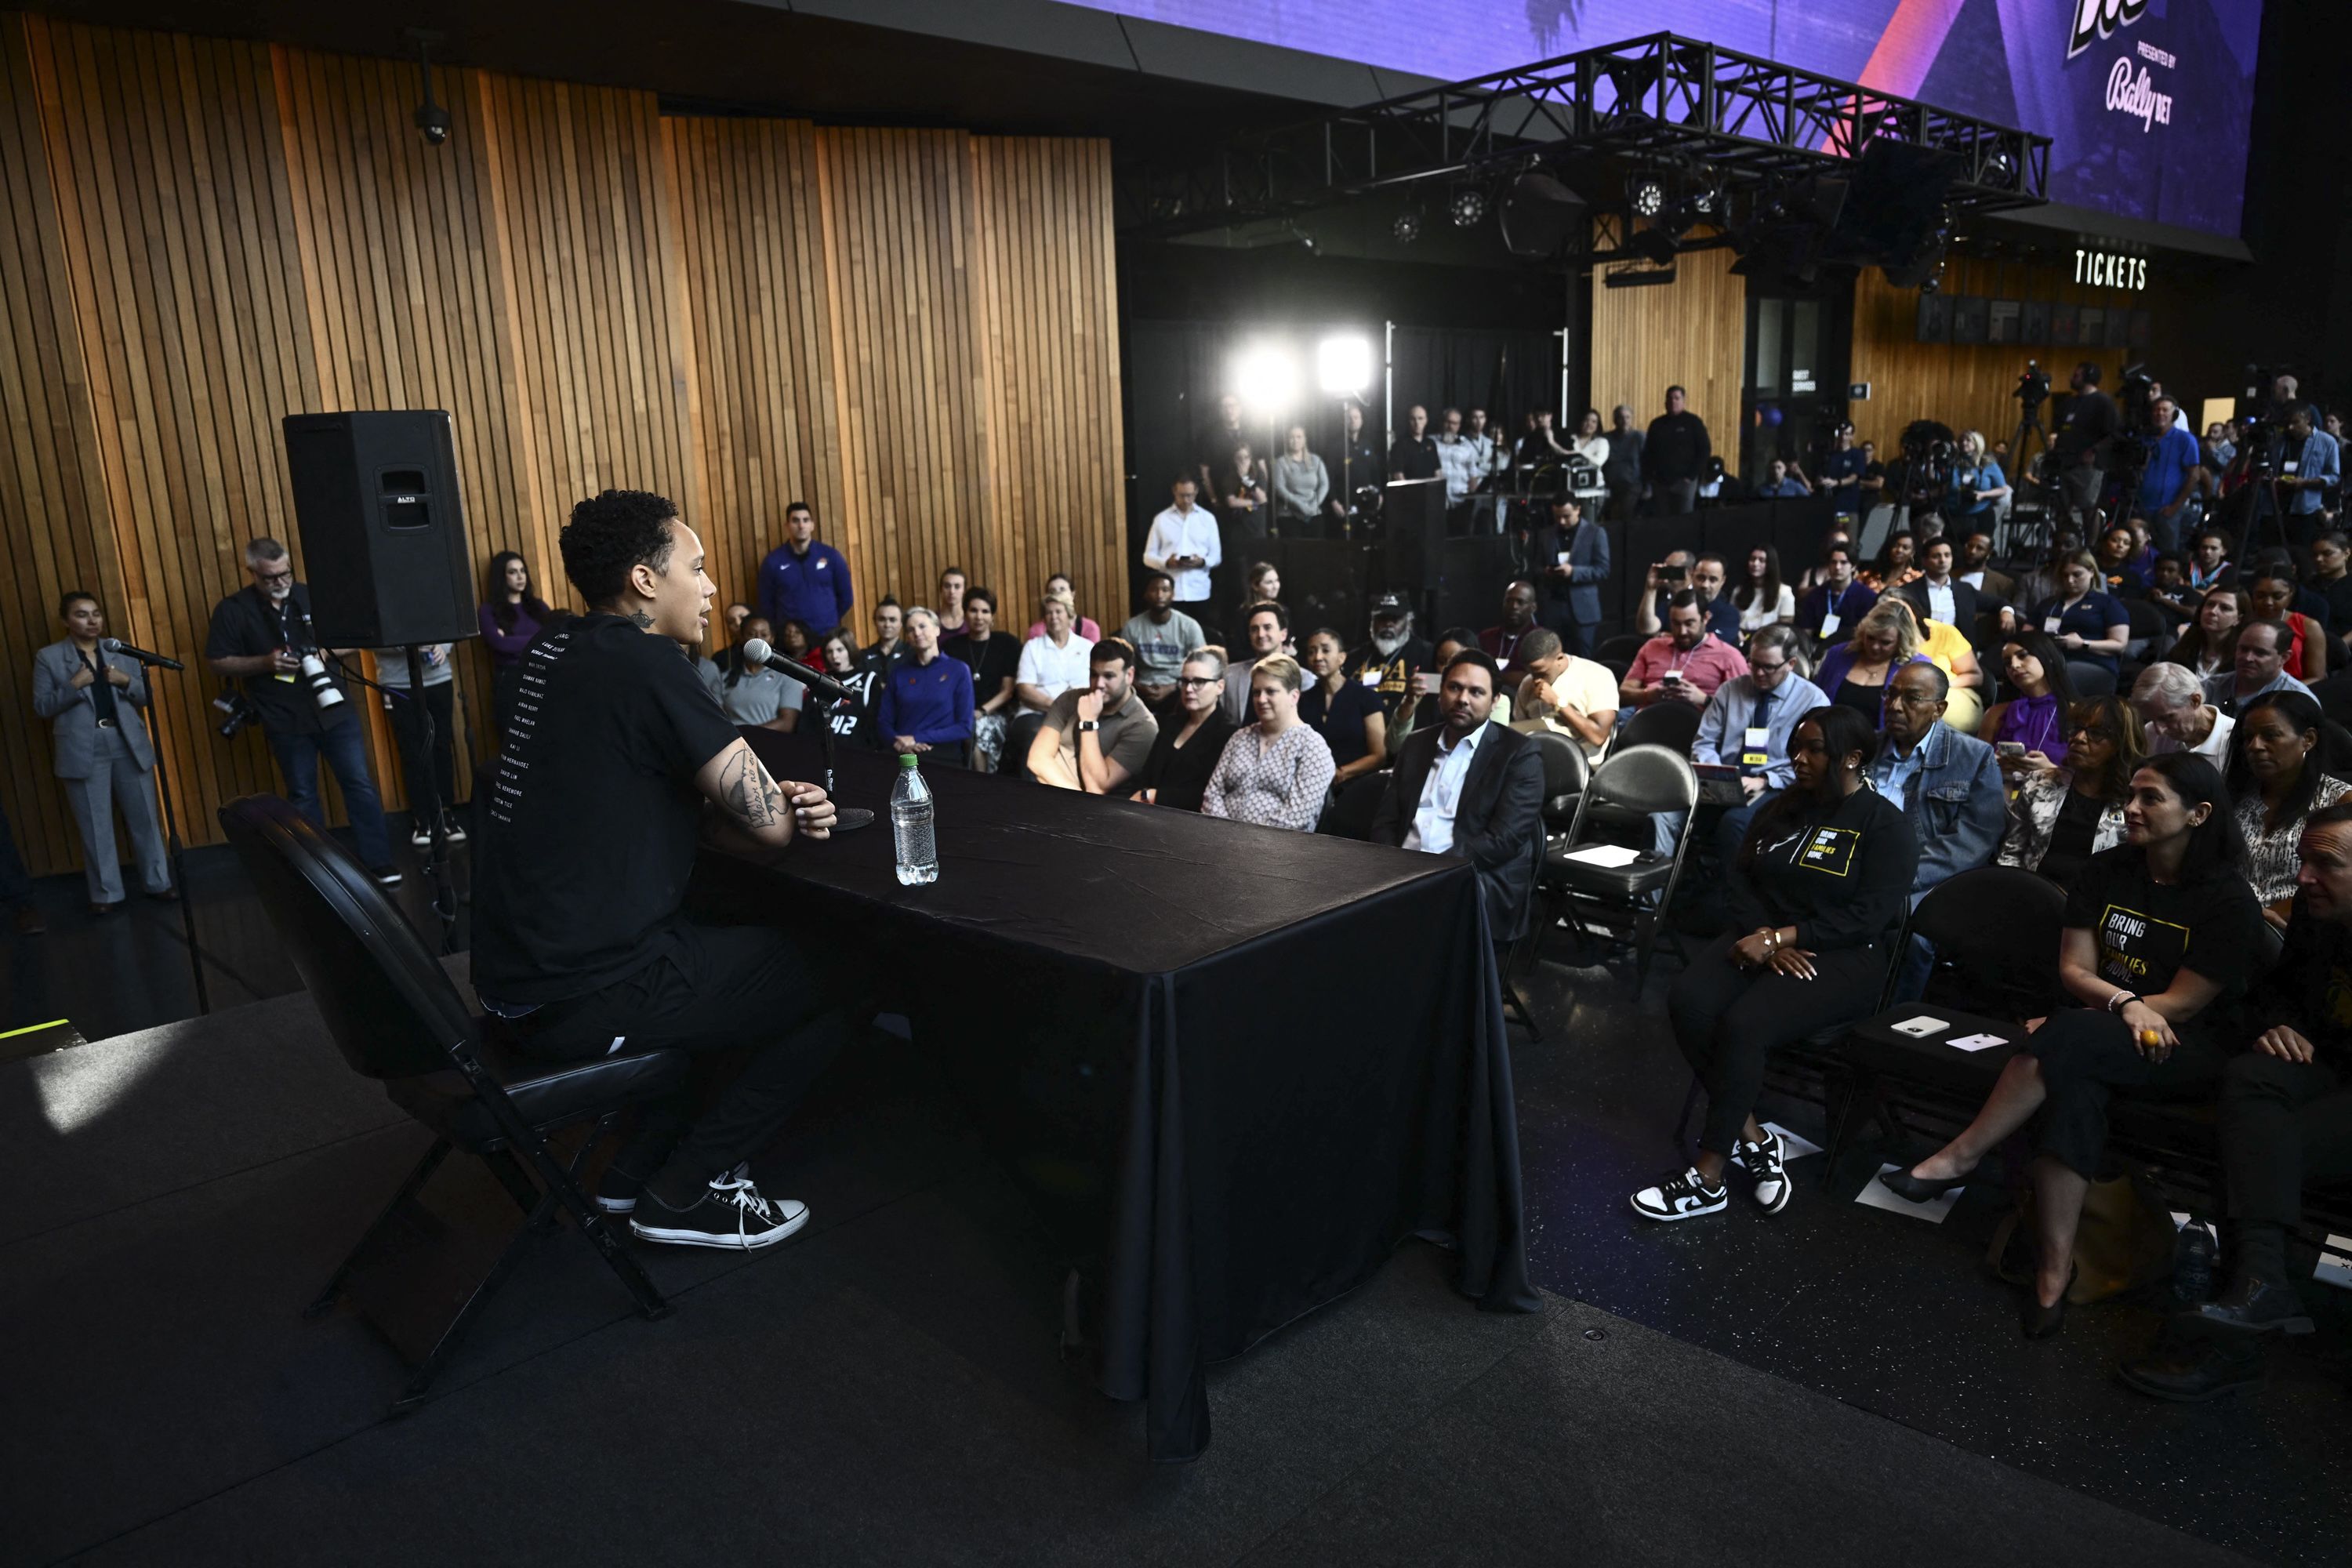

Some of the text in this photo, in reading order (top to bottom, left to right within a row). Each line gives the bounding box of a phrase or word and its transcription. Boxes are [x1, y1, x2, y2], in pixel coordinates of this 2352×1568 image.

[2137, 40, 2176, 70] PRESENTED BY
[2106, 56, 2172, 133] Bally BET
[2075, 249, 2147, 291] TICKETS
[831, 715, 858, 735] 42
[507, 757, 529, 768] HERNANDEZ
[750, 770, 757, 782] no
[1811, 844, 1835, 854] FAMILIES
[2108, 913, 2146, 937] BRING
[2106, 931, 2127, 950] OUR
